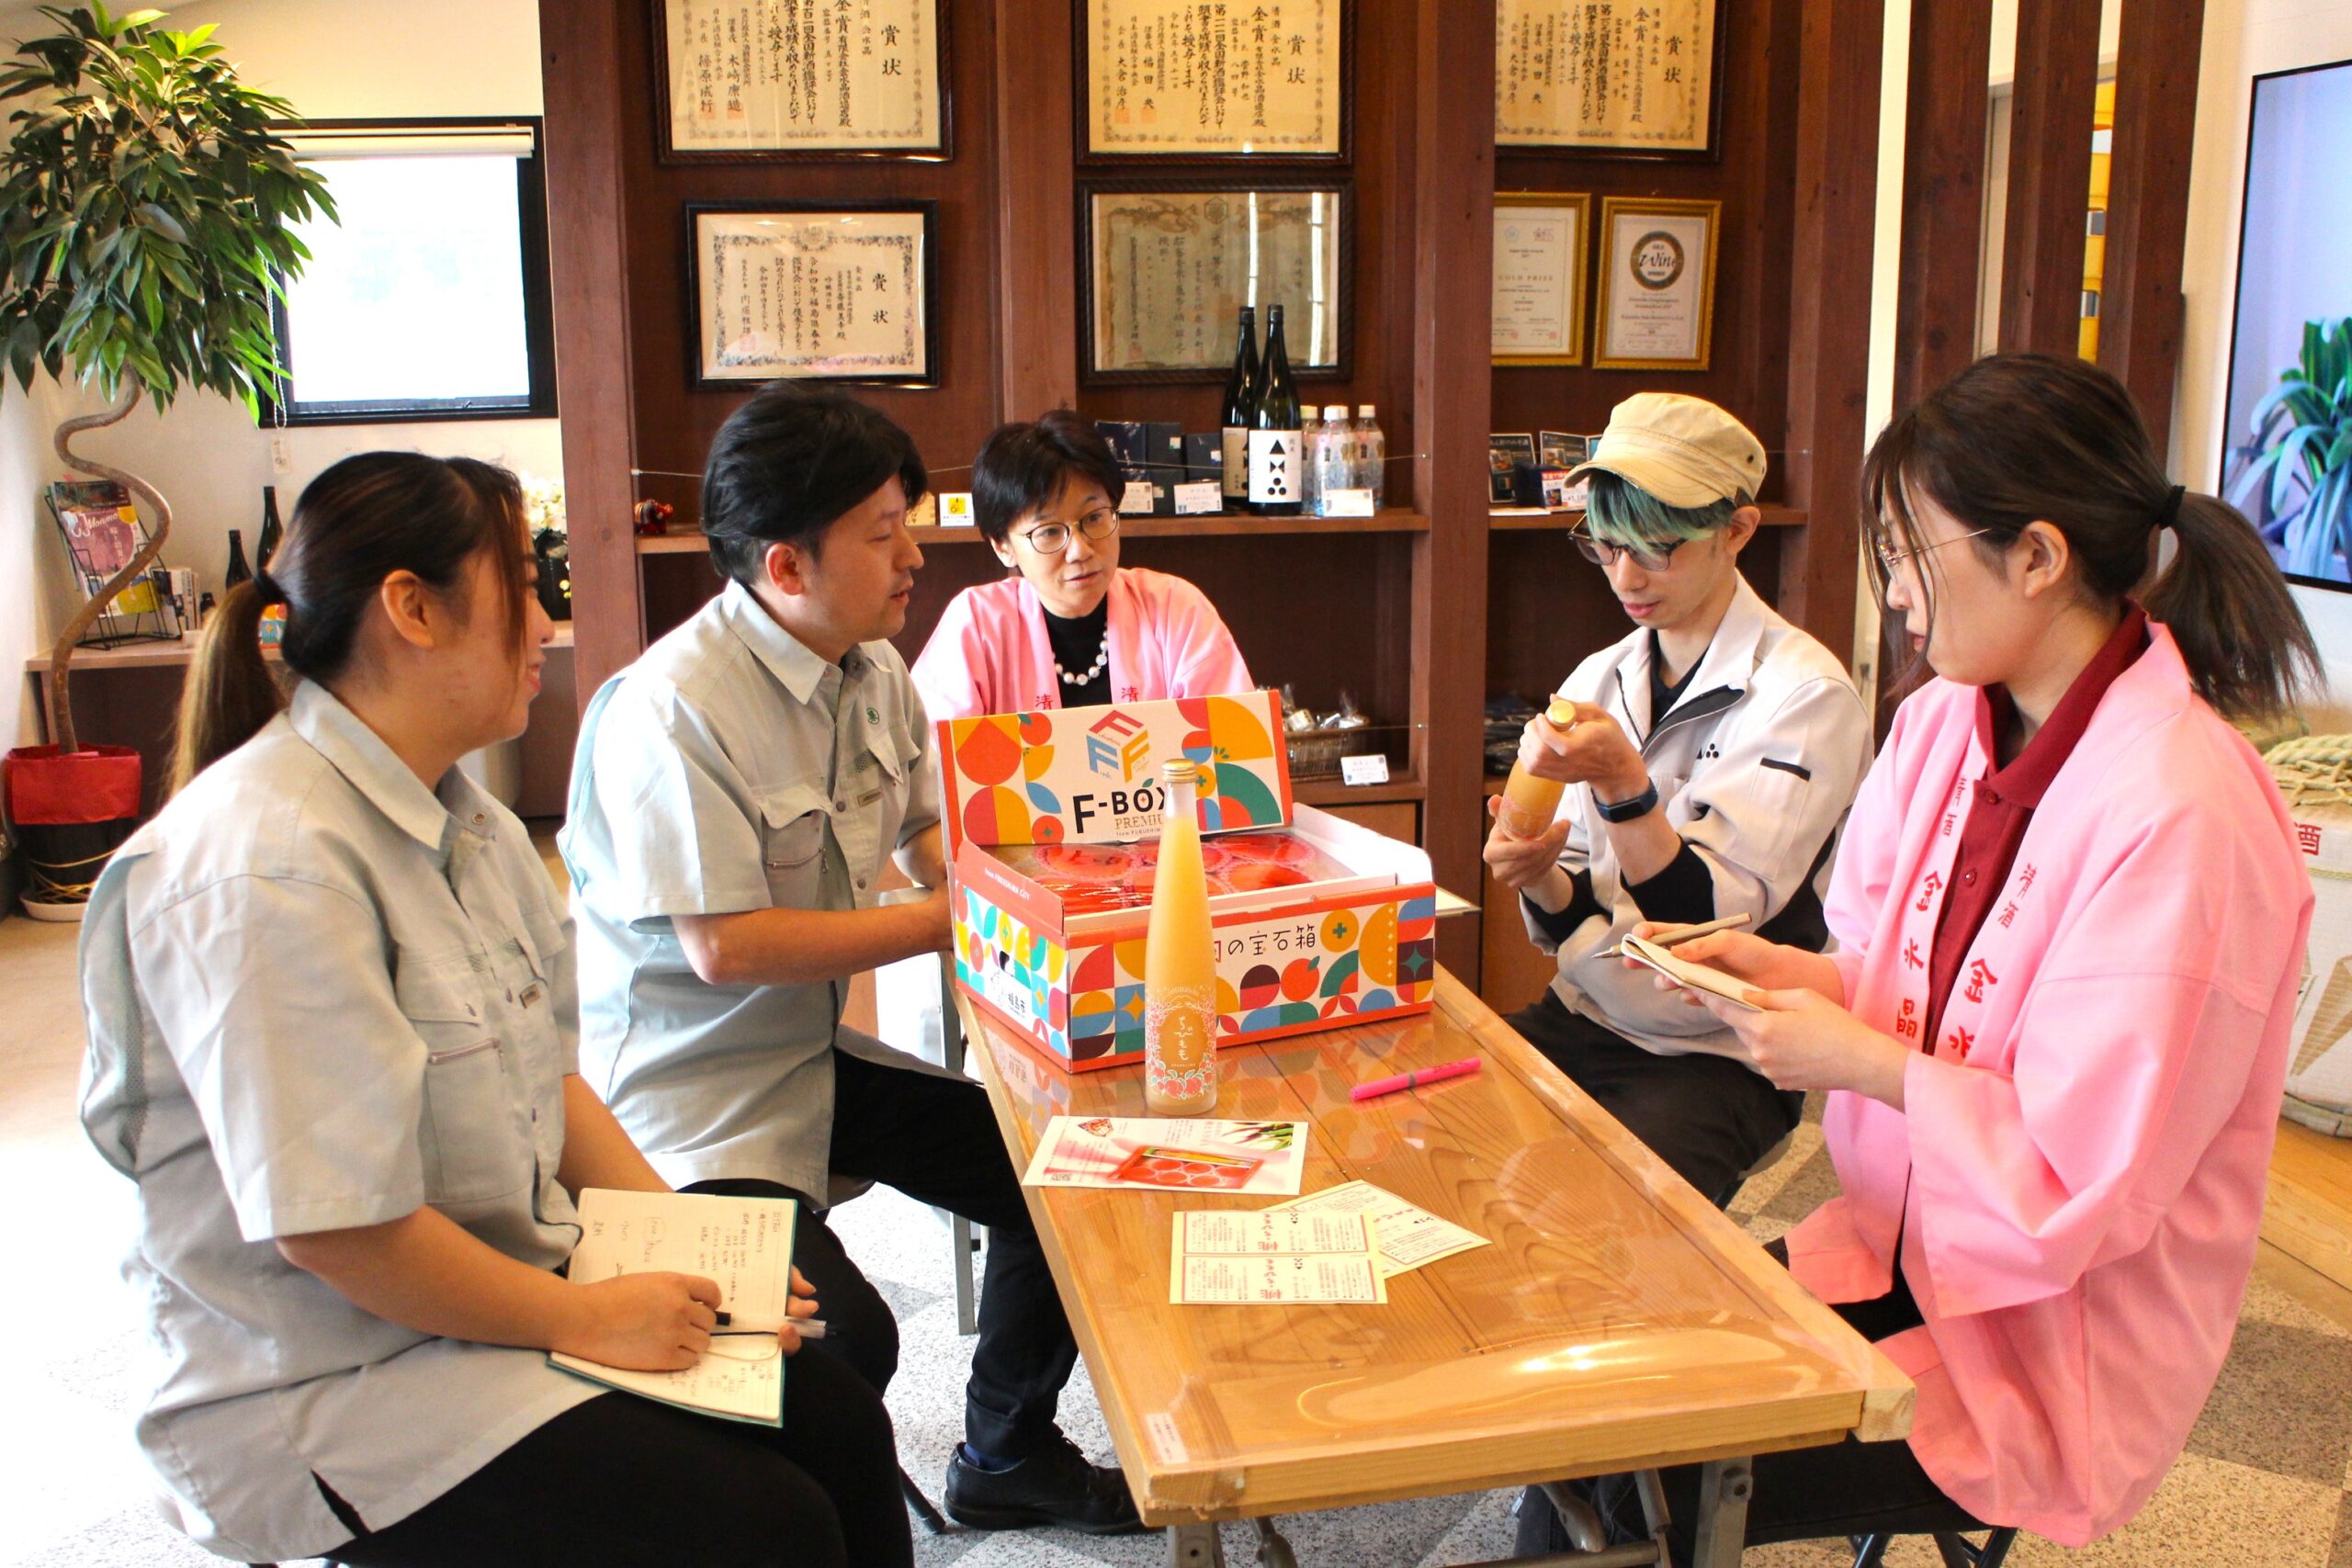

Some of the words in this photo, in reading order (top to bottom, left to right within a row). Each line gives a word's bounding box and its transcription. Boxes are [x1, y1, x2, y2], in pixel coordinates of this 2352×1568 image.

[1251, 6, 1269, 43] 金賞
[1634, 6, 1650, 43] 金賞
[881, 24, 902, 76] 賞状
[1287, 33, 1306, 85] 賞状
[1663, 35, 1683, 84] 賞状
[873, 273, 888, 324] 賞状
